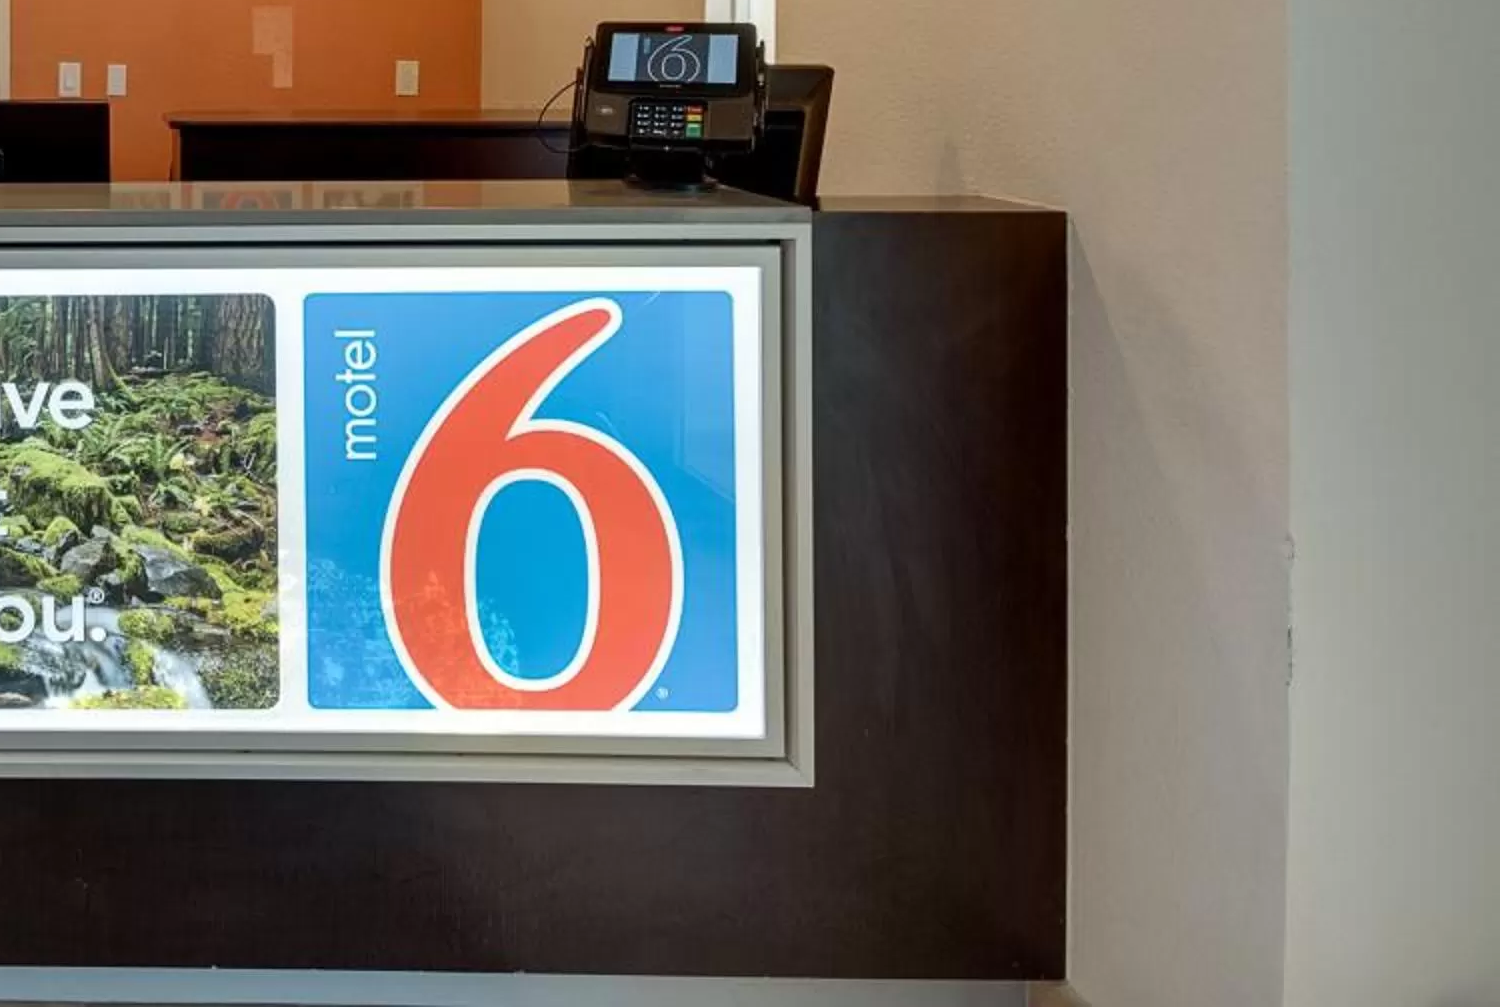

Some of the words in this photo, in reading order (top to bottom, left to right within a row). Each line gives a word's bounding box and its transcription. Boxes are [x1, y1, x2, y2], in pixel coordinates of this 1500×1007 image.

[647, 34, 700, 82] 6
[334, 330, 376, 460] motel
[379, 297, 684, 711] 6
